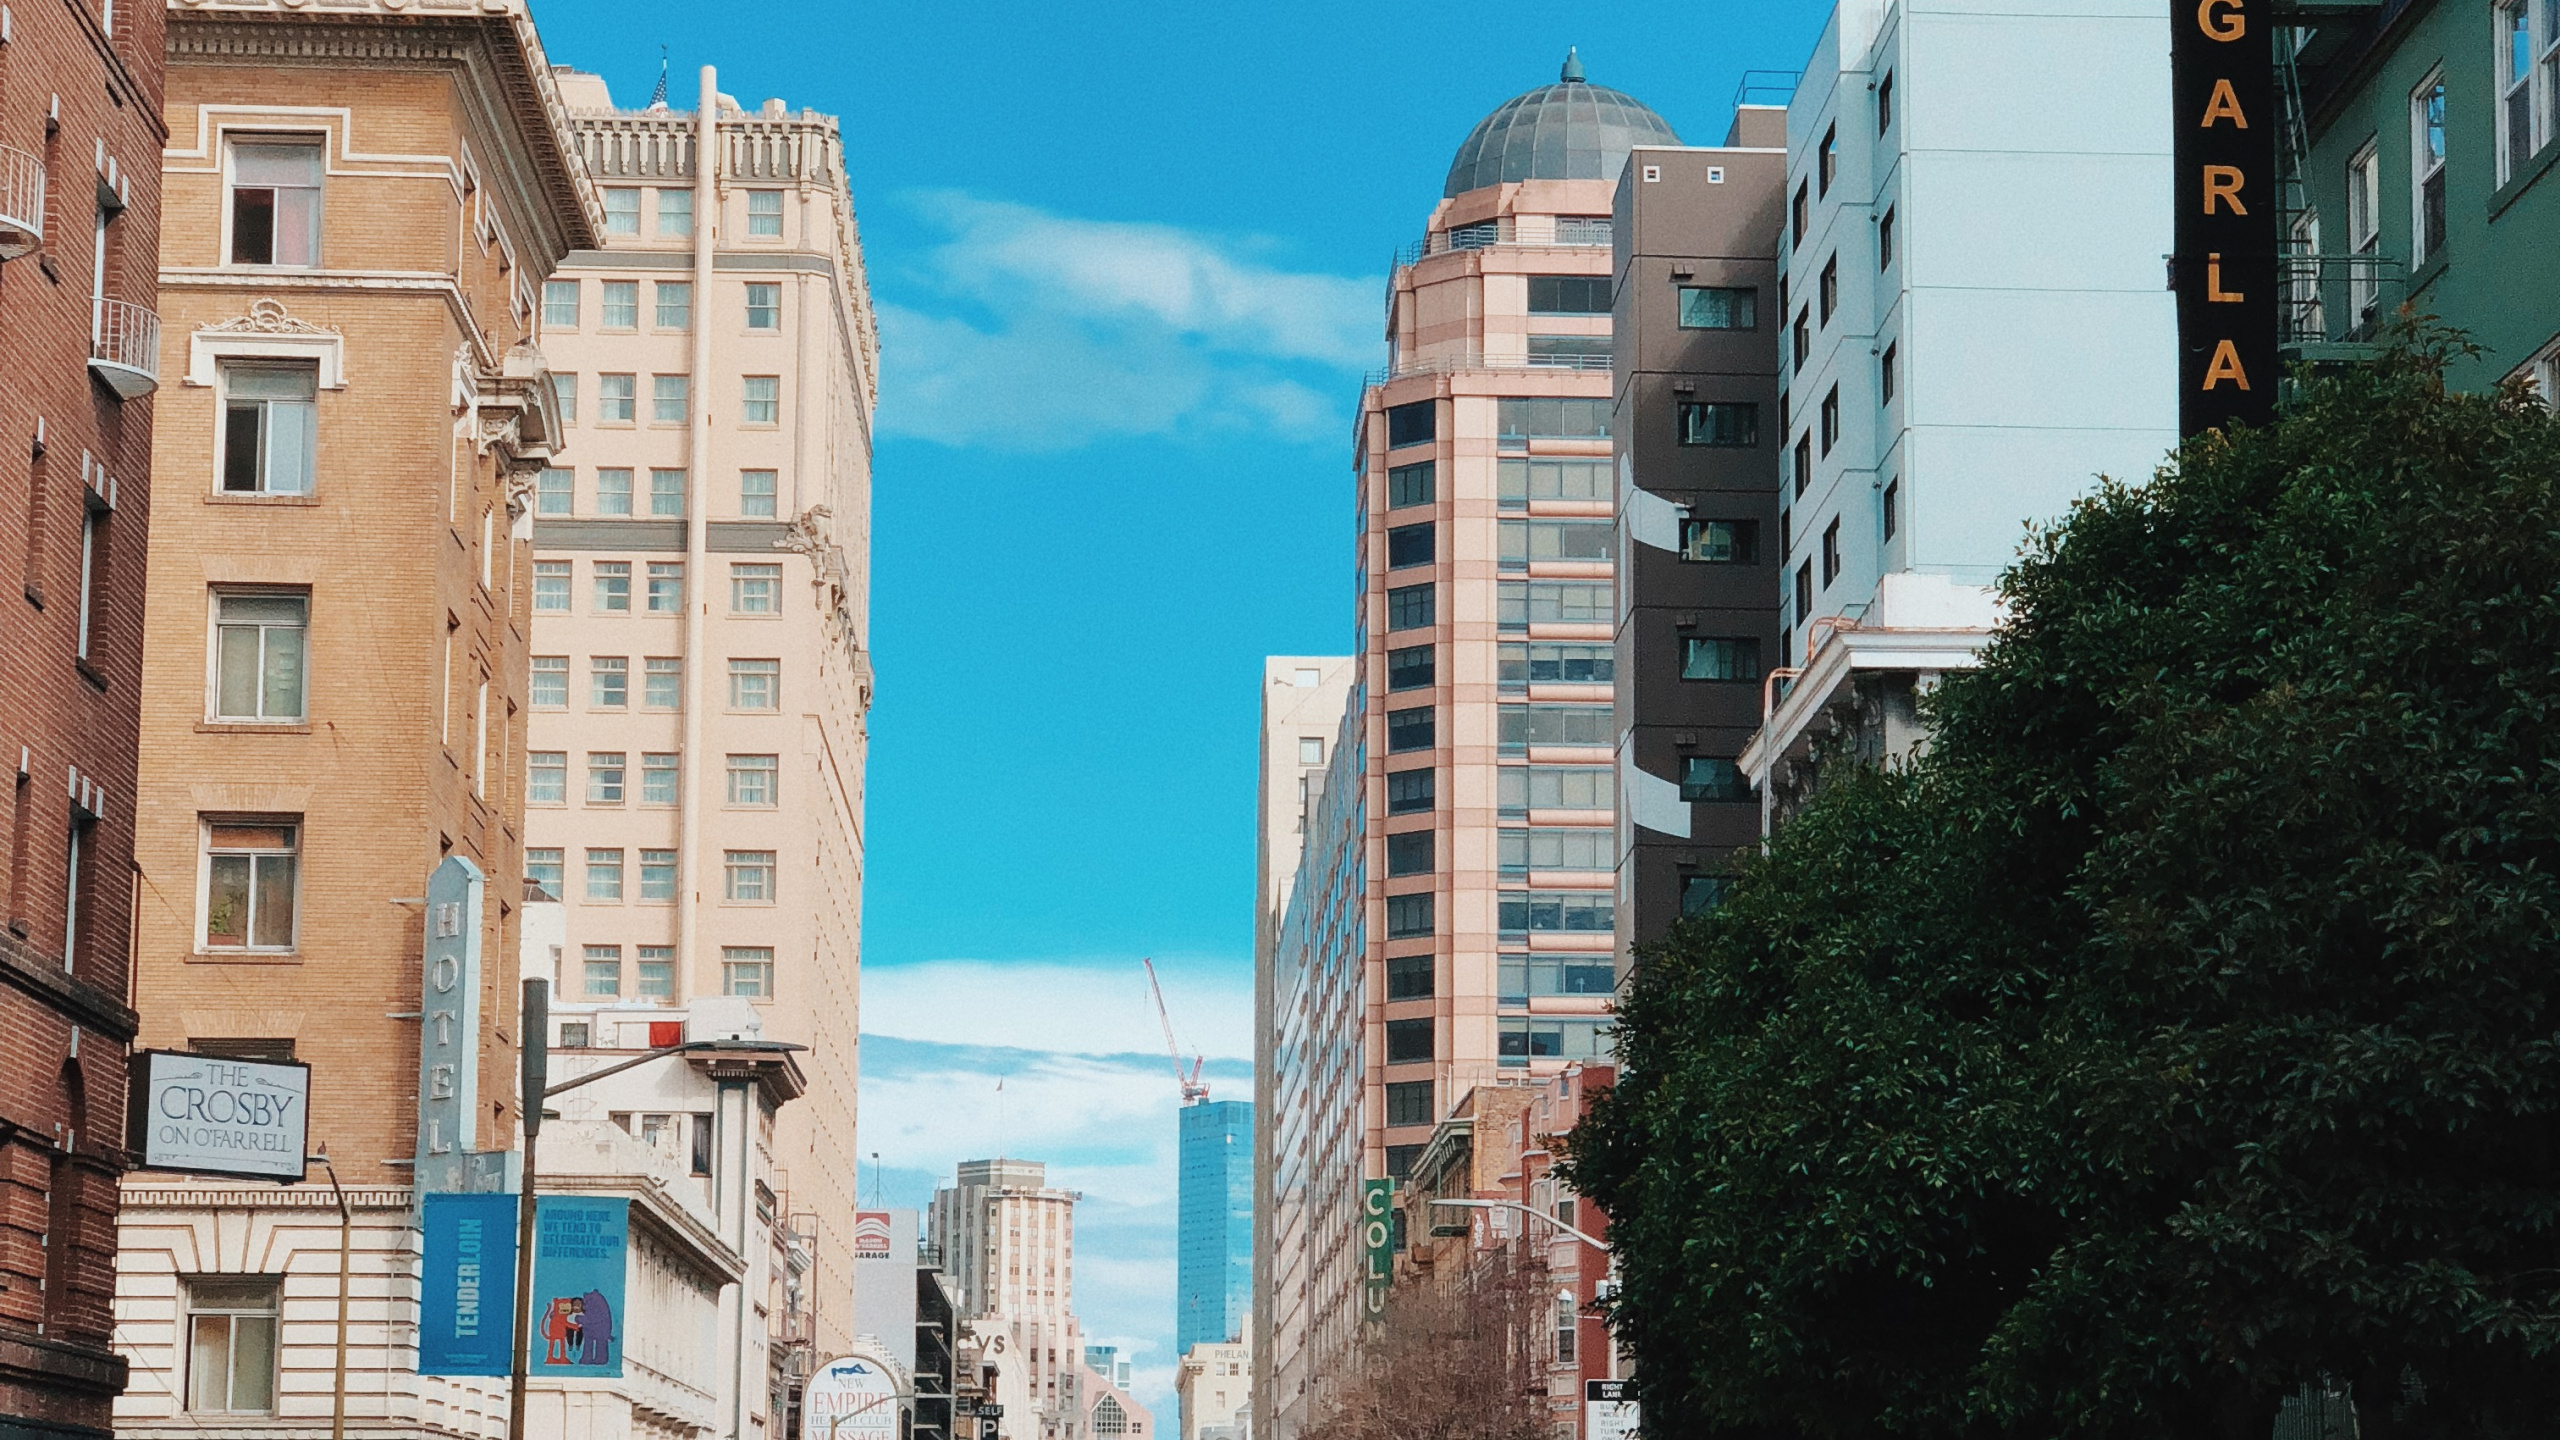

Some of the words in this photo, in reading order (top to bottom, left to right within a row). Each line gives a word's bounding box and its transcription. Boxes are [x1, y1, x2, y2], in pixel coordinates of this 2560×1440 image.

[2197, 0, 2251, 448] GARLA
[428, 901, 461, 1154] HOTEL
[206, 1063, 249, 1087] THE
[160, 1085, 294, 1128] CROSBY
[159, 1125, 190, 1145] ON
[194, 1128, 292, 1153] O'FARRELL
[544, 1209, 584, 1221] AROUND
[585, 1210, 611, 1222] HERE
[543, 1221, 558, 1233] WE
[562, 1222, 587, 1233] TEND
[589, 1223, 602, 1234] TO
[543, 1233, 597, 1246] CELEBRATE
[600, 1235, 619, 1247] OUR
[455, 1219, 482, 1339] TENDERLOIN
[1214, 1349, 1249, 1359] PHELAN
[838, 1378, 865, 1389] NEW
[1601, 1383, 1624, 1391] RIGHT
[813, 1391, 890, 1415] EMPIRE
[978, 1406, 1003, 1416] SELF
[811, 1415, 857, 1425] HETH
[860, 1415, 891, 1425] CLUB
[812, 1430, 890, 1440] MSSAGE
[982, 1420, 997, 1438] P
